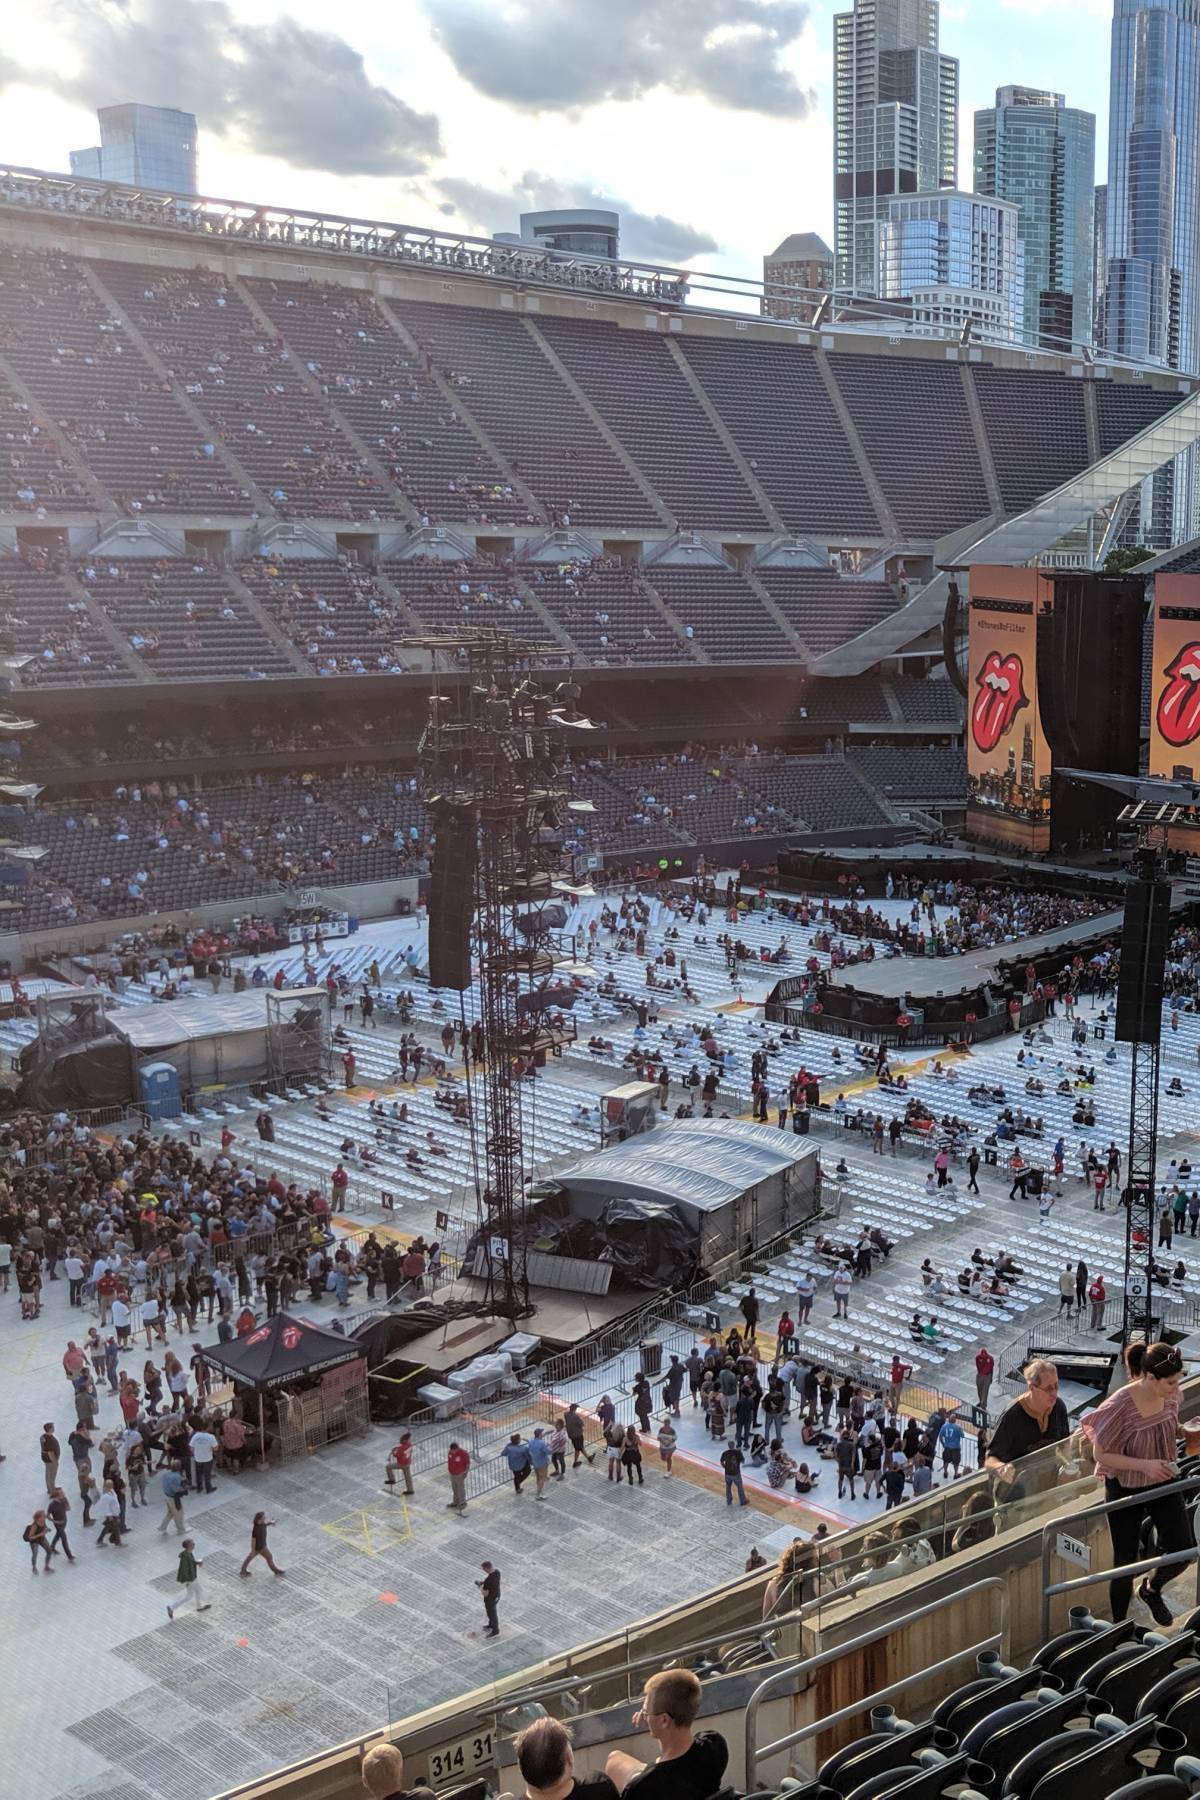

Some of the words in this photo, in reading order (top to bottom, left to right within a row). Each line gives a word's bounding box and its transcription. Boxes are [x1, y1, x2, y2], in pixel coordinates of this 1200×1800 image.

[302, 893, 314, 904] 5W
[847, 1117, 854, 1128] F
[988, 1152, 994, 1162] F
[384, 1193, 391, 1206] K
[710, 1317, 717, 1329] J
[787, 1339, 796, 1353] H
[267, 1369, 305, 1388] OFFICIAL
[976, 1411, 983, 1427] H
[945, 1428, 954, 1438] 17
[1064, 1539, 1082, 1557] 314
[432, 1746, 464, 1777] 314
[473, 1733, 497, 1760] 31
